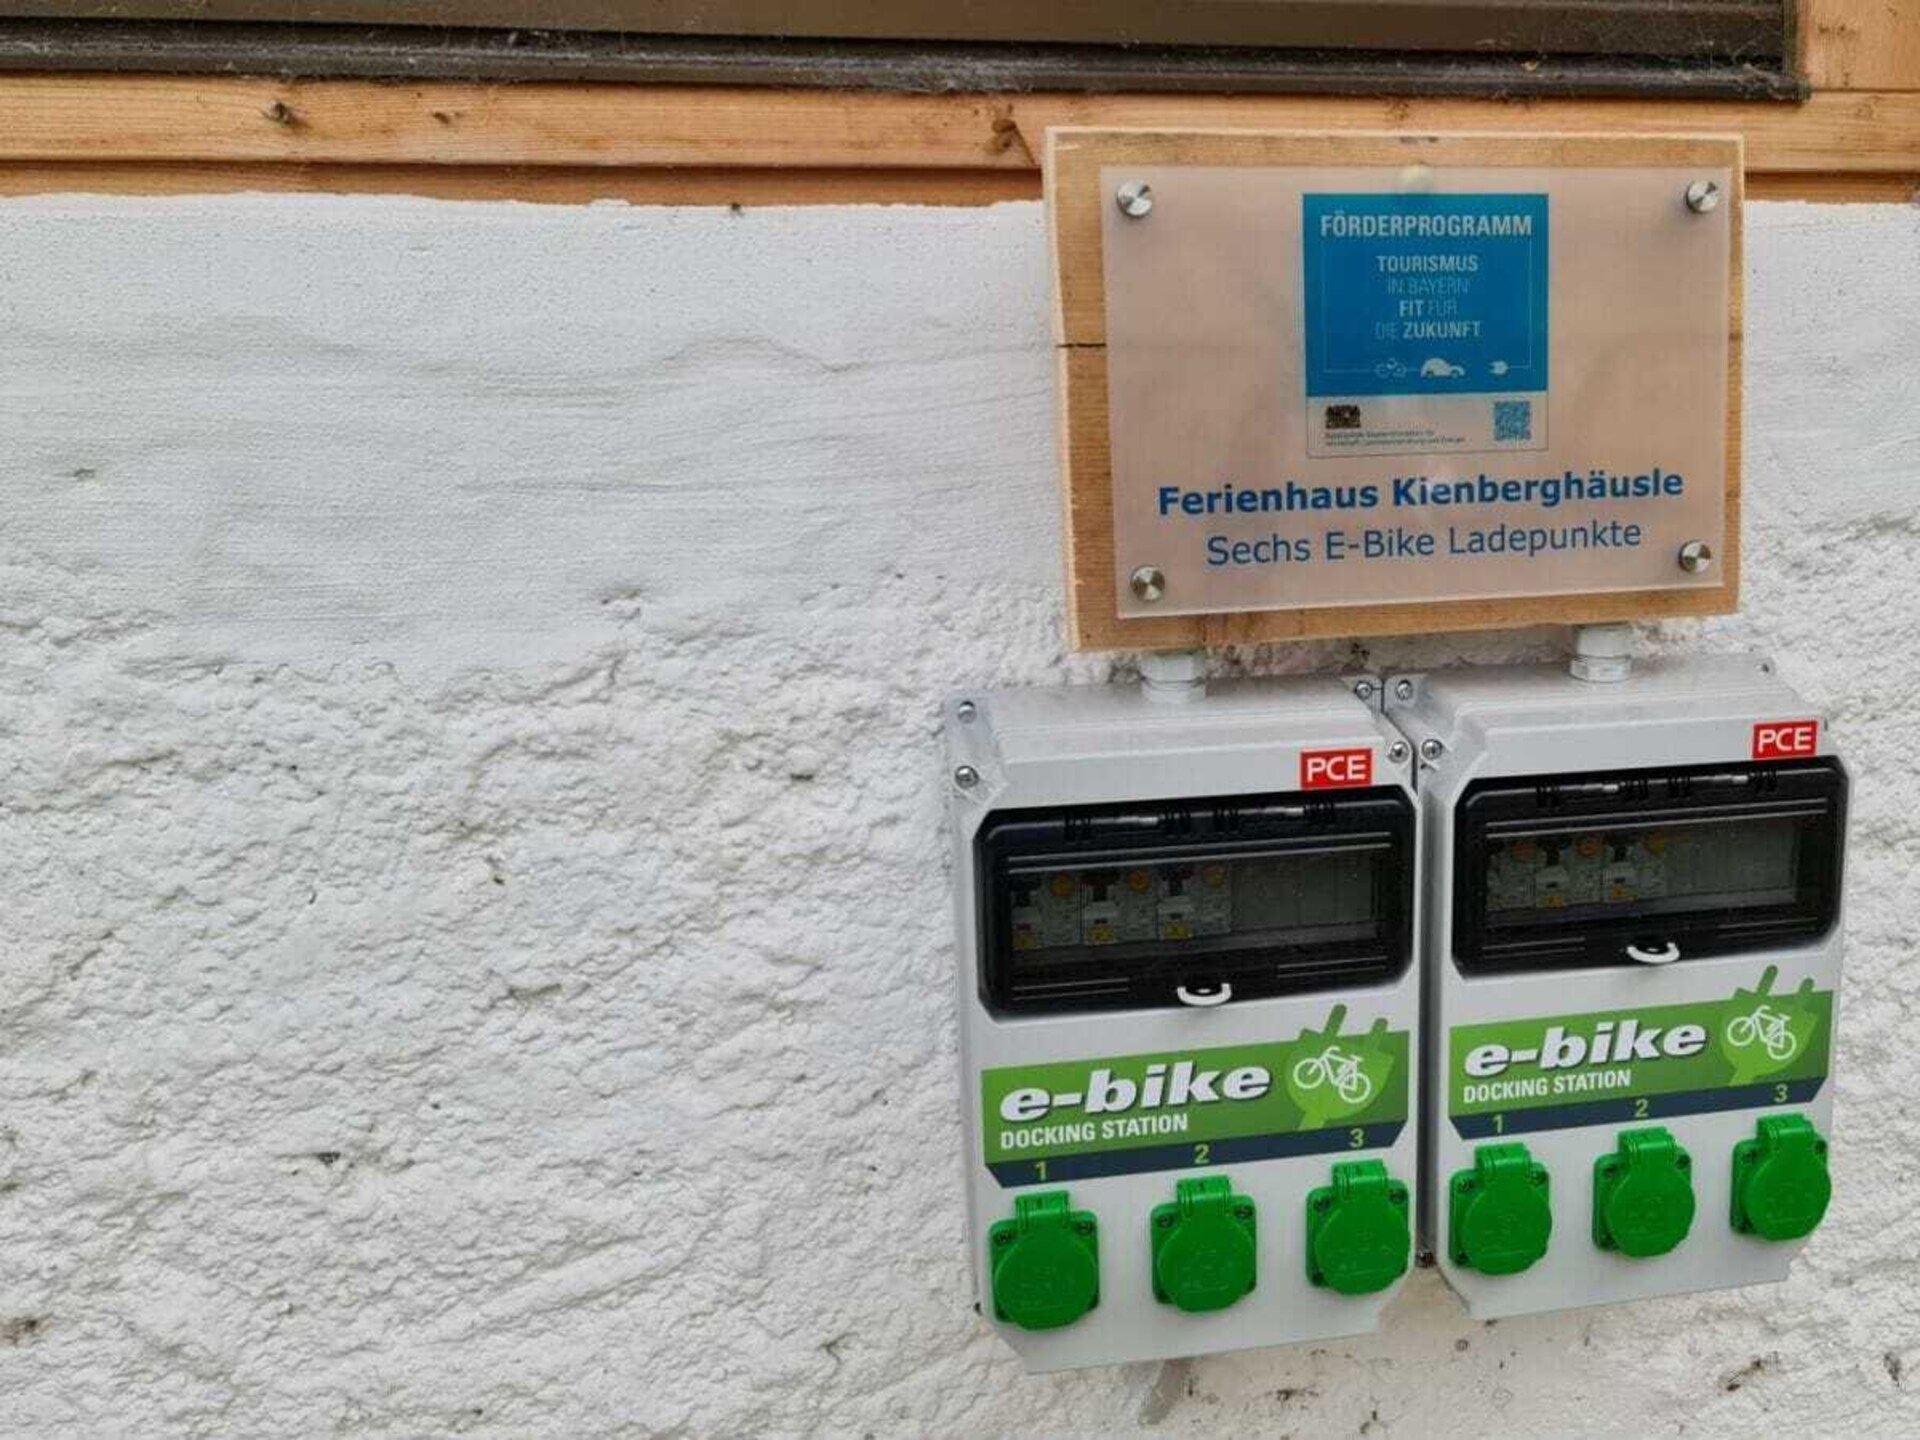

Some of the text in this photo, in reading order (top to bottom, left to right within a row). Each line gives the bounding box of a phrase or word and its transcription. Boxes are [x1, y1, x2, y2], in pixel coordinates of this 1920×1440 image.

[1320, 211, 1532, 237] FÖRDERPROGRAMM
[1376, 254, 1479, 273] TOURISMUS
[1388, 277, 1468, 295] IN BAYERN
[1399, 299, 1424, 317] FIT
[1403, 320, 1481, 339] ZUKUNFT
[1158, 469, 1683, 515] Ferienhaus Kienberghäusle
[1207, 520, 1641, 566] Sechs E-Bike Ladepunkte
[1757, 727, 1812, 753] PCE
[1306, 755, 1367, 782] PCE
[1463, 1019, 1706, 1077] e-bike
[1000, 1061, 1271, 1122] e-bike
[1463, 1069, 1631, 1103] DOCKING STATION
[1492, 1083, 1788, 1134] 1 2 3
[1000, 1113, 1188, 1150] DOCKING STATION
[1034, 1128, 1364, 1182] 1 2 3
